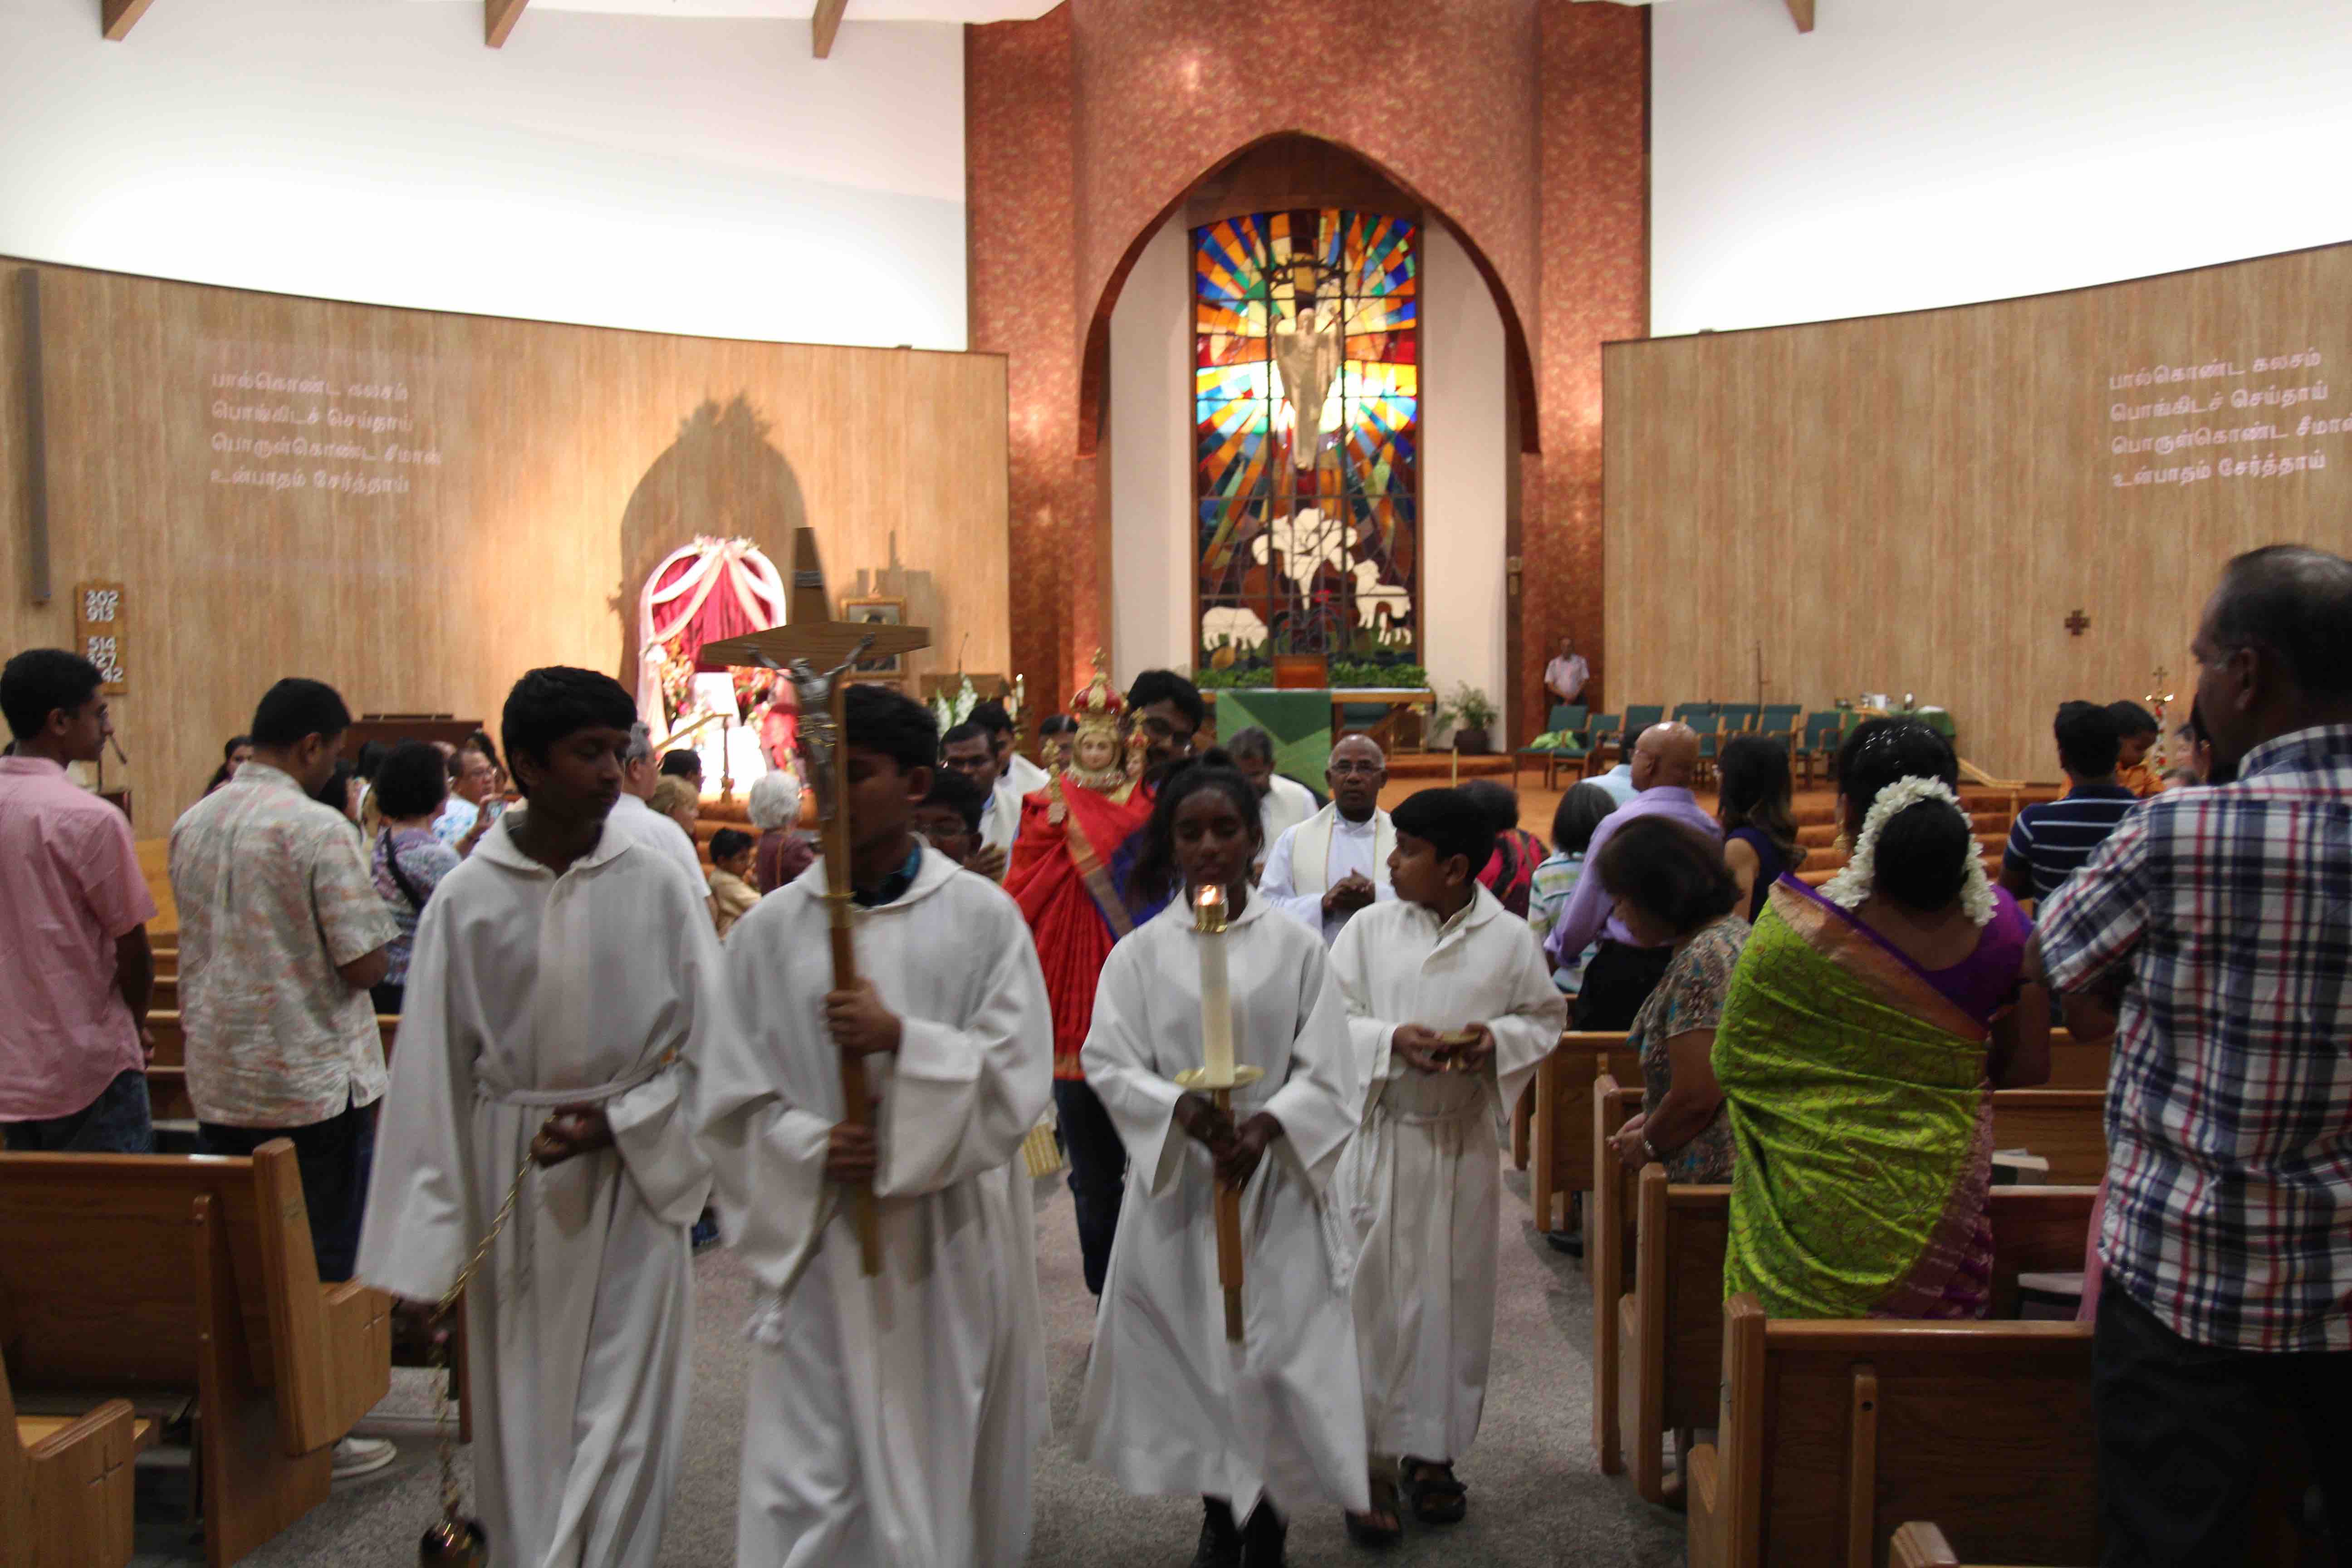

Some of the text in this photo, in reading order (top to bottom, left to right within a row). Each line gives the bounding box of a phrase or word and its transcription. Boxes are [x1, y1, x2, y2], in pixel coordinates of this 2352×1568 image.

[2109, 347, 2321, 390] பால்கொண்ட கலசம்
[2111, 379, 2329, 421] பொங்கிடச் செய்தாய்
[2218, 449, 2326, 479] சேர்த்தாய்
[88, 636, 116, 652] 514
[101, 667, 123, 683] 42
